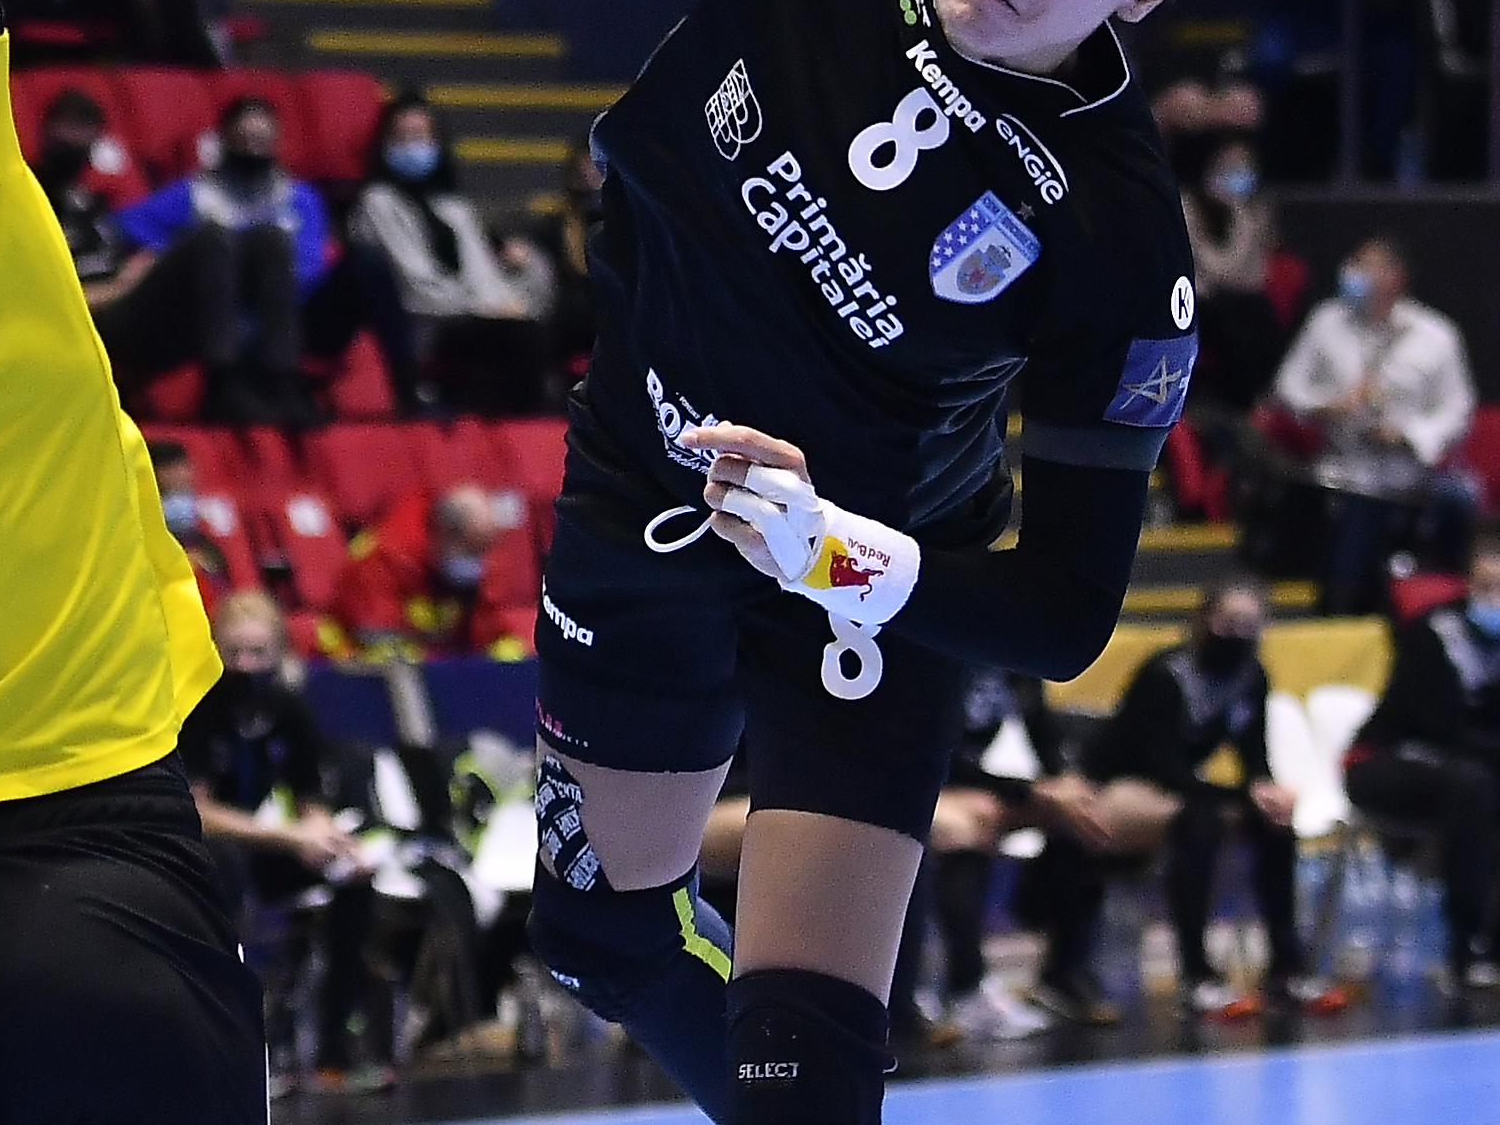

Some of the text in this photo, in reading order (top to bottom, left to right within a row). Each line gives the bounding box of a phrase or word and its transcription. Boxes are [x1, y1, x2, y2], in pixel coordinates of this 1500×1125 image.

[906, 39, 987, 133] Kempa
[848, 86, 950, 191] 8
[741, 176, 890, 349] Capitalei
[766, 150, 904, 341] Primăria
[542, 576, 594, 647] empa
[821, 611, 884, 700] 8
[737, 1061, 800, 1080] SELECT
